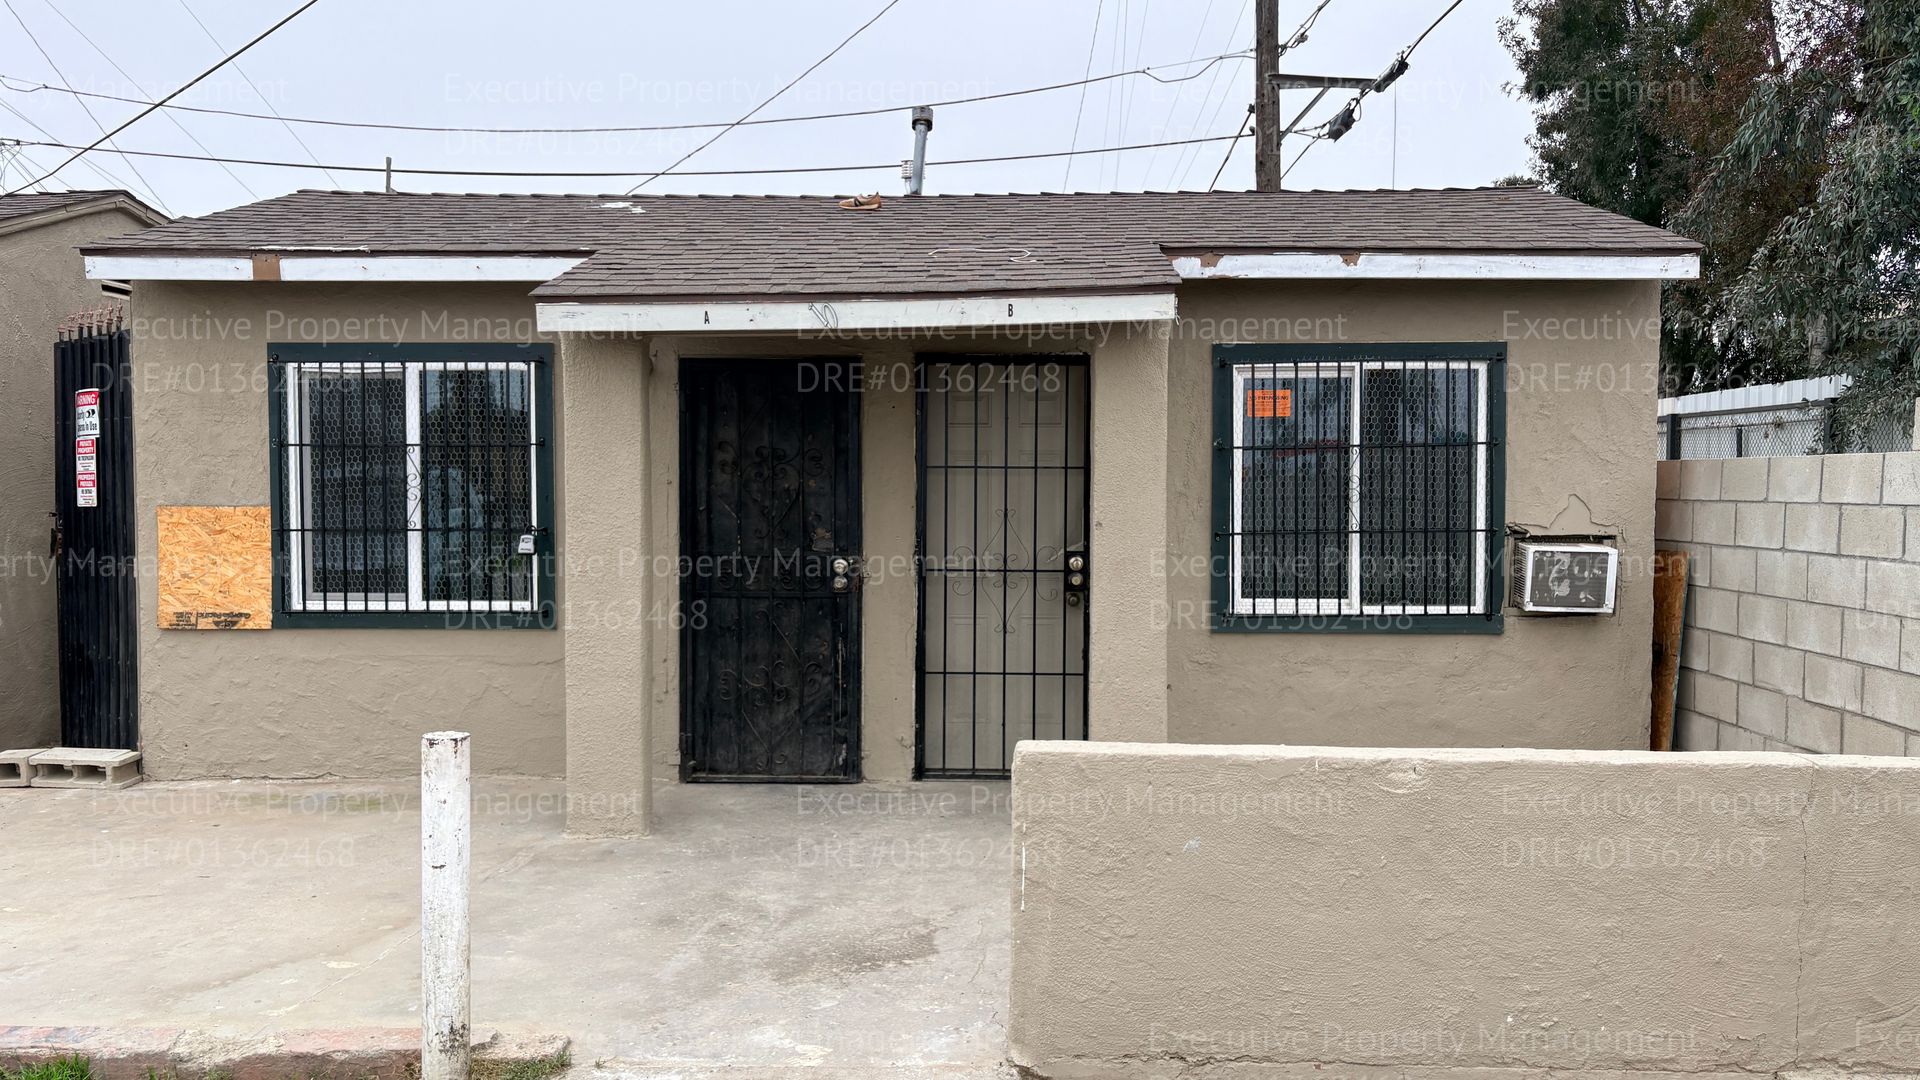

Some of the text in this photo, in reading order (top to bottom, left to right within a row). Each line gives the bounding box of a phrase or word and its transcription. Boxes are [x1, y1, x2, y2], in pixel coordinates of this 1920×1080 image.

[704, 310, 710, 325] A
[1008, 304, 1014, 318] B
[77, 394, 96, 406] ARNING
